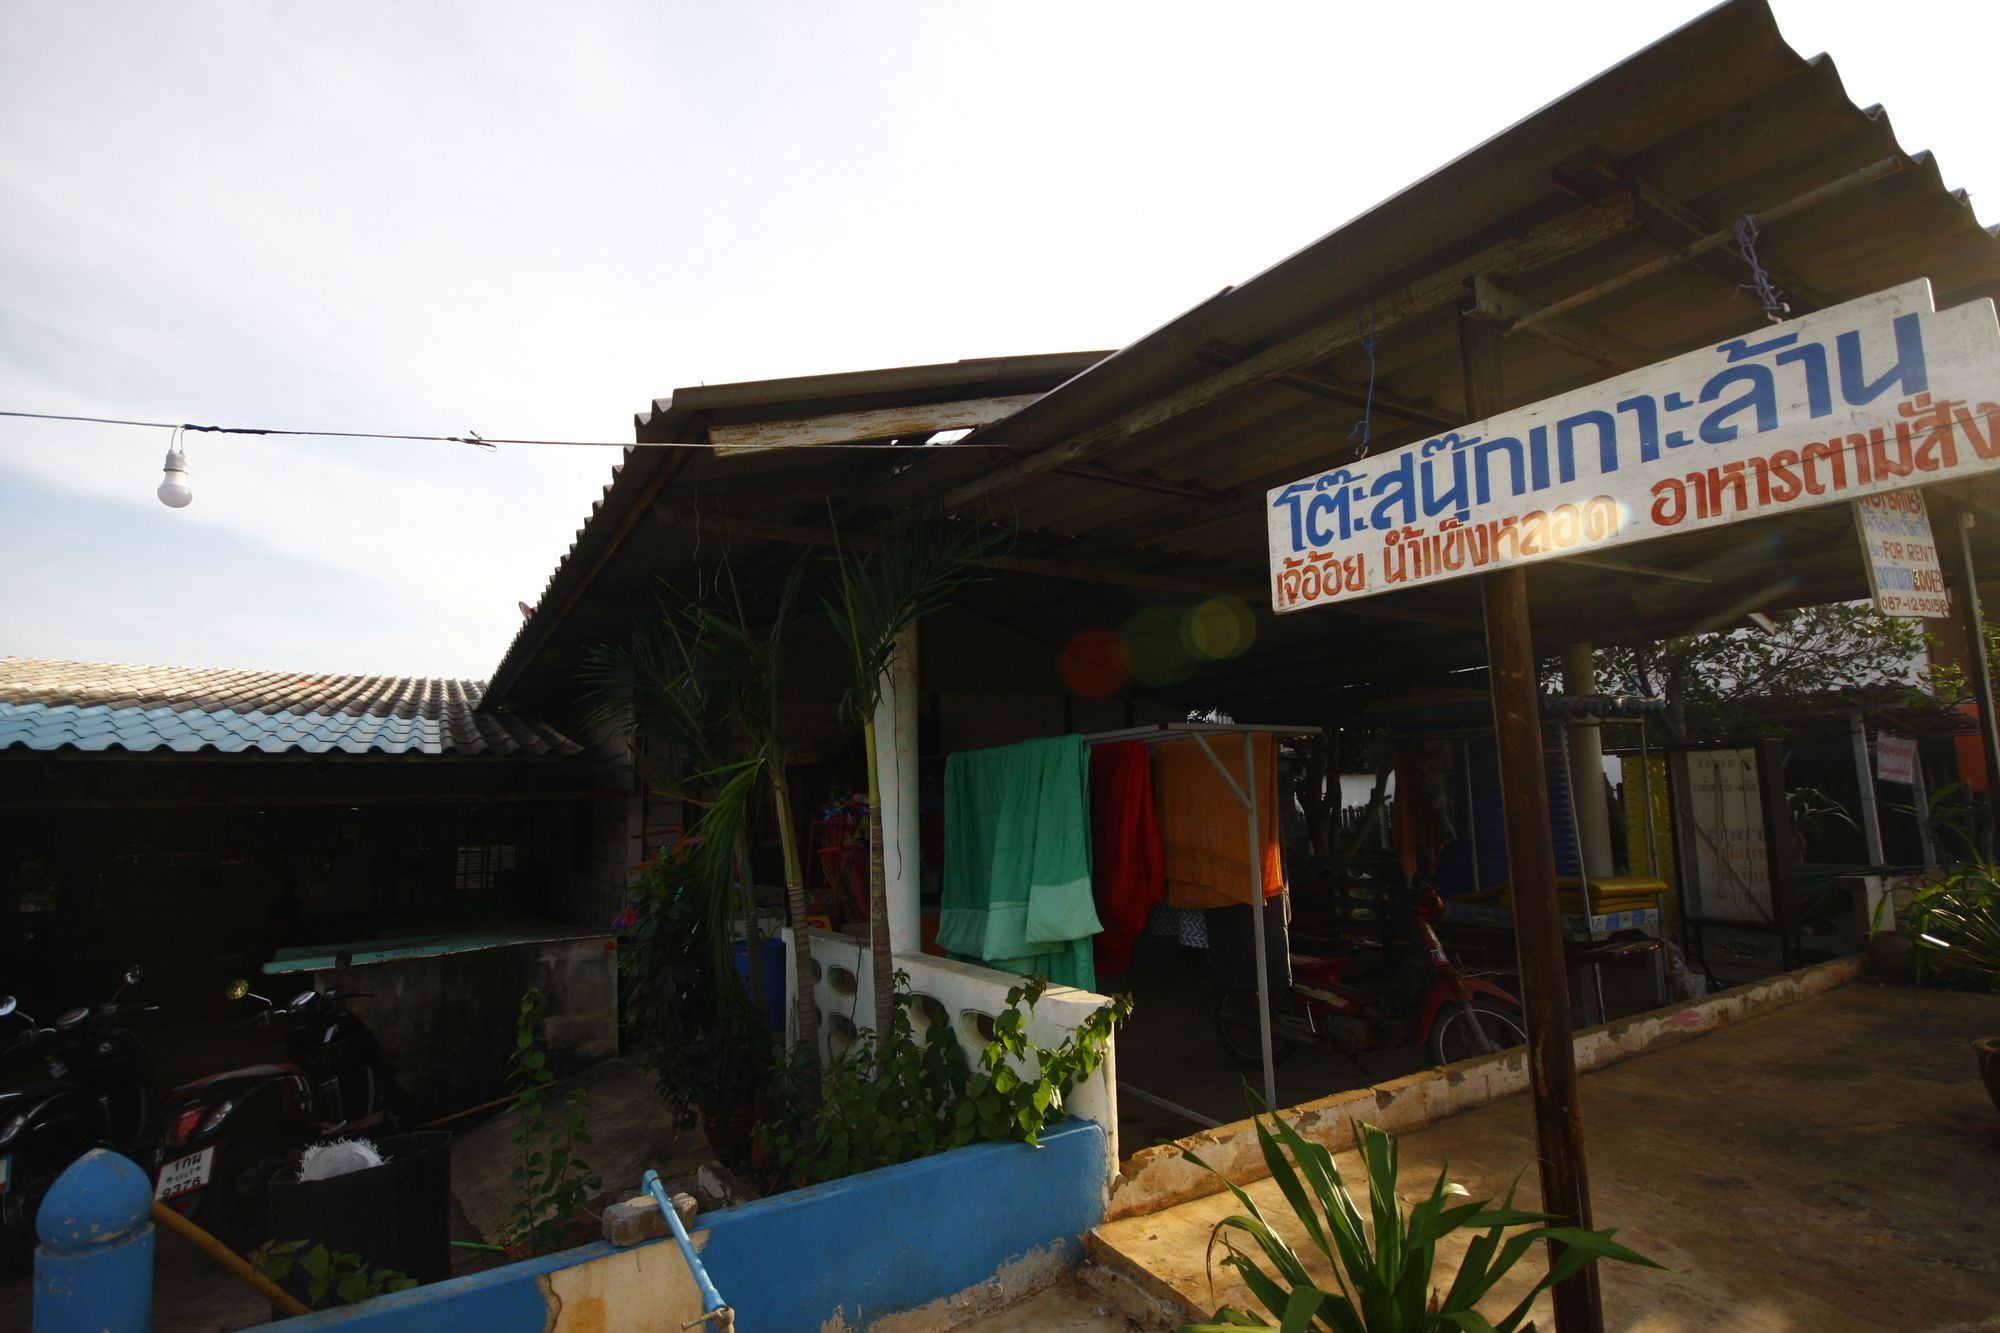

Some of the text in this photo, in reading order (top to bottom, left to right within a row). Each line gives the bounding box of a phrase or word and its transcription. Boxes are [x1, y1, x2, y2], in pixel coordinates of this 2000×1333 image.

[1272, 311, 1929, 553] โต๊ะสนุ๊กเกาะล้าน
[1275, 390, 2000, 608] เจ้อ้อย น้ำแข็งหลอด อาหารตามสั่ง
[1881, 540, 1904, 560] FOR
[1906, 543, 1934, 563] RENT
